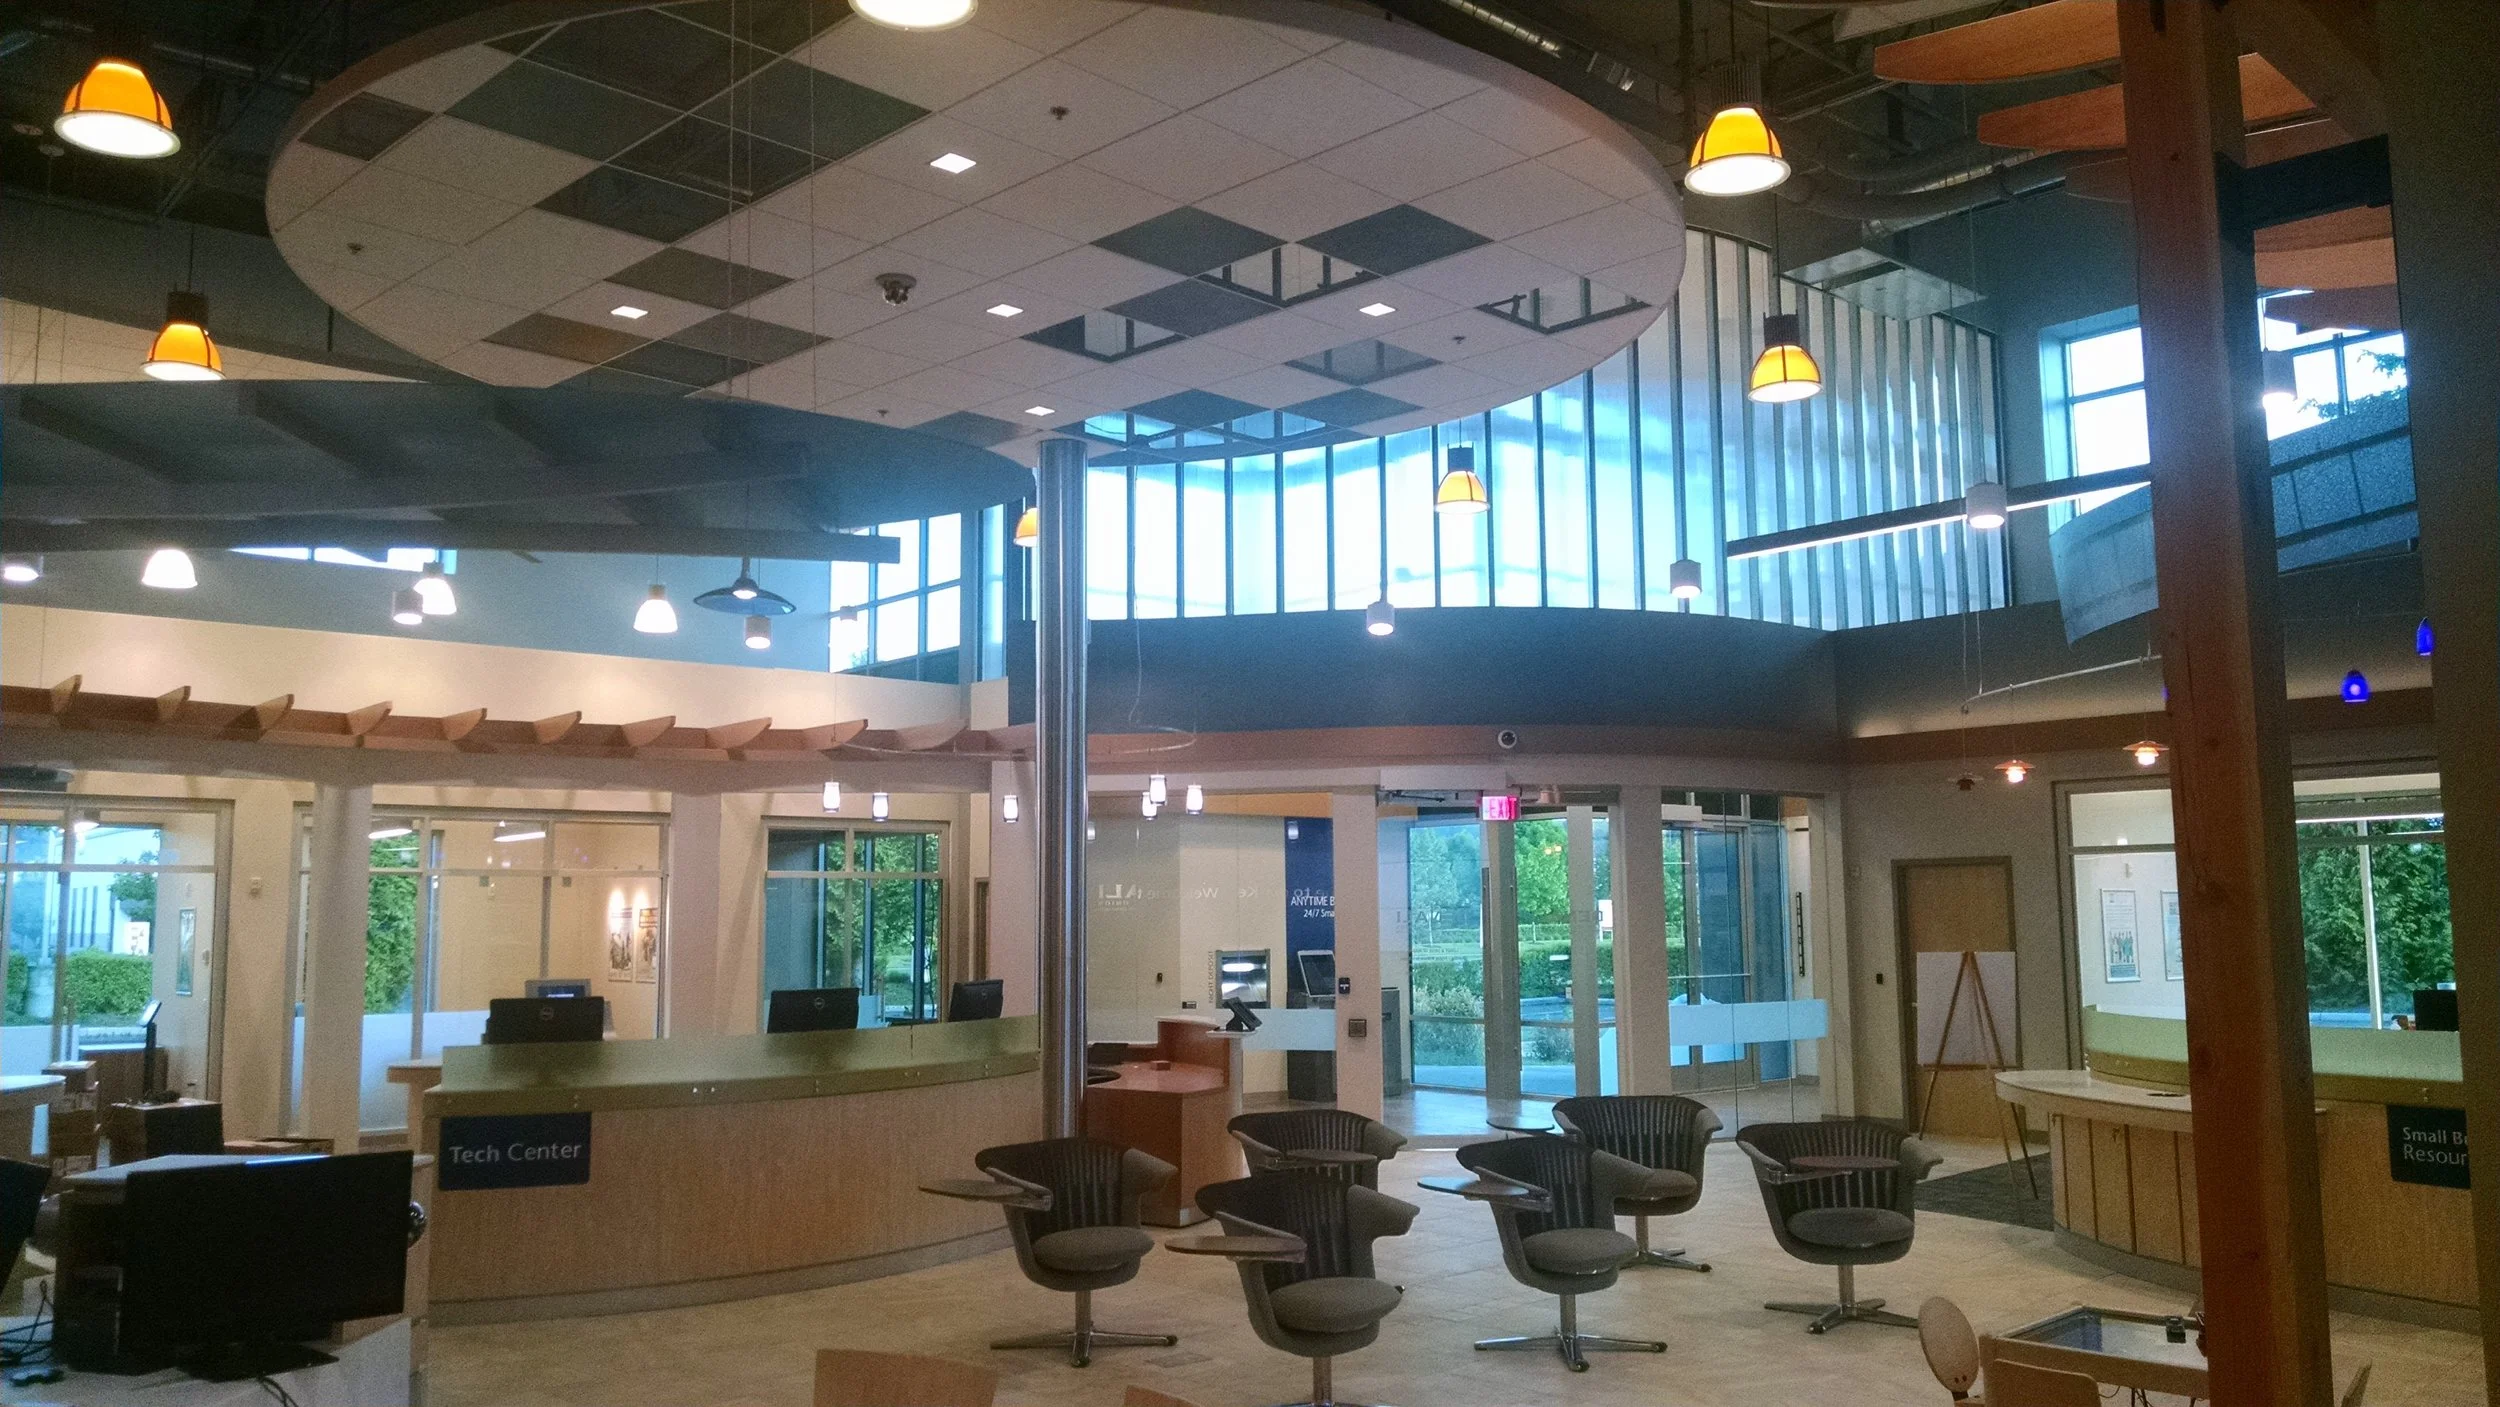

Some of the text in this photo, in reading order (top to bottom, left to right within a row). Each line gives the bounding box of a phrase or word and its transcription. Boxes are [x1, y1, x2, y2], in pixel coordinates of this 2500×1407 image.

[1489, 797, 1517, 819] EXIT
[1290, 896, 1328, 906] ANYTIME
[1303, 909, 1320, 918] 24/7
[2402, 1127, 2447, 1144] Small
[449, 1142, 582, 1164] Tech Center
[2403, 1143, 2467, 1166] Resour
